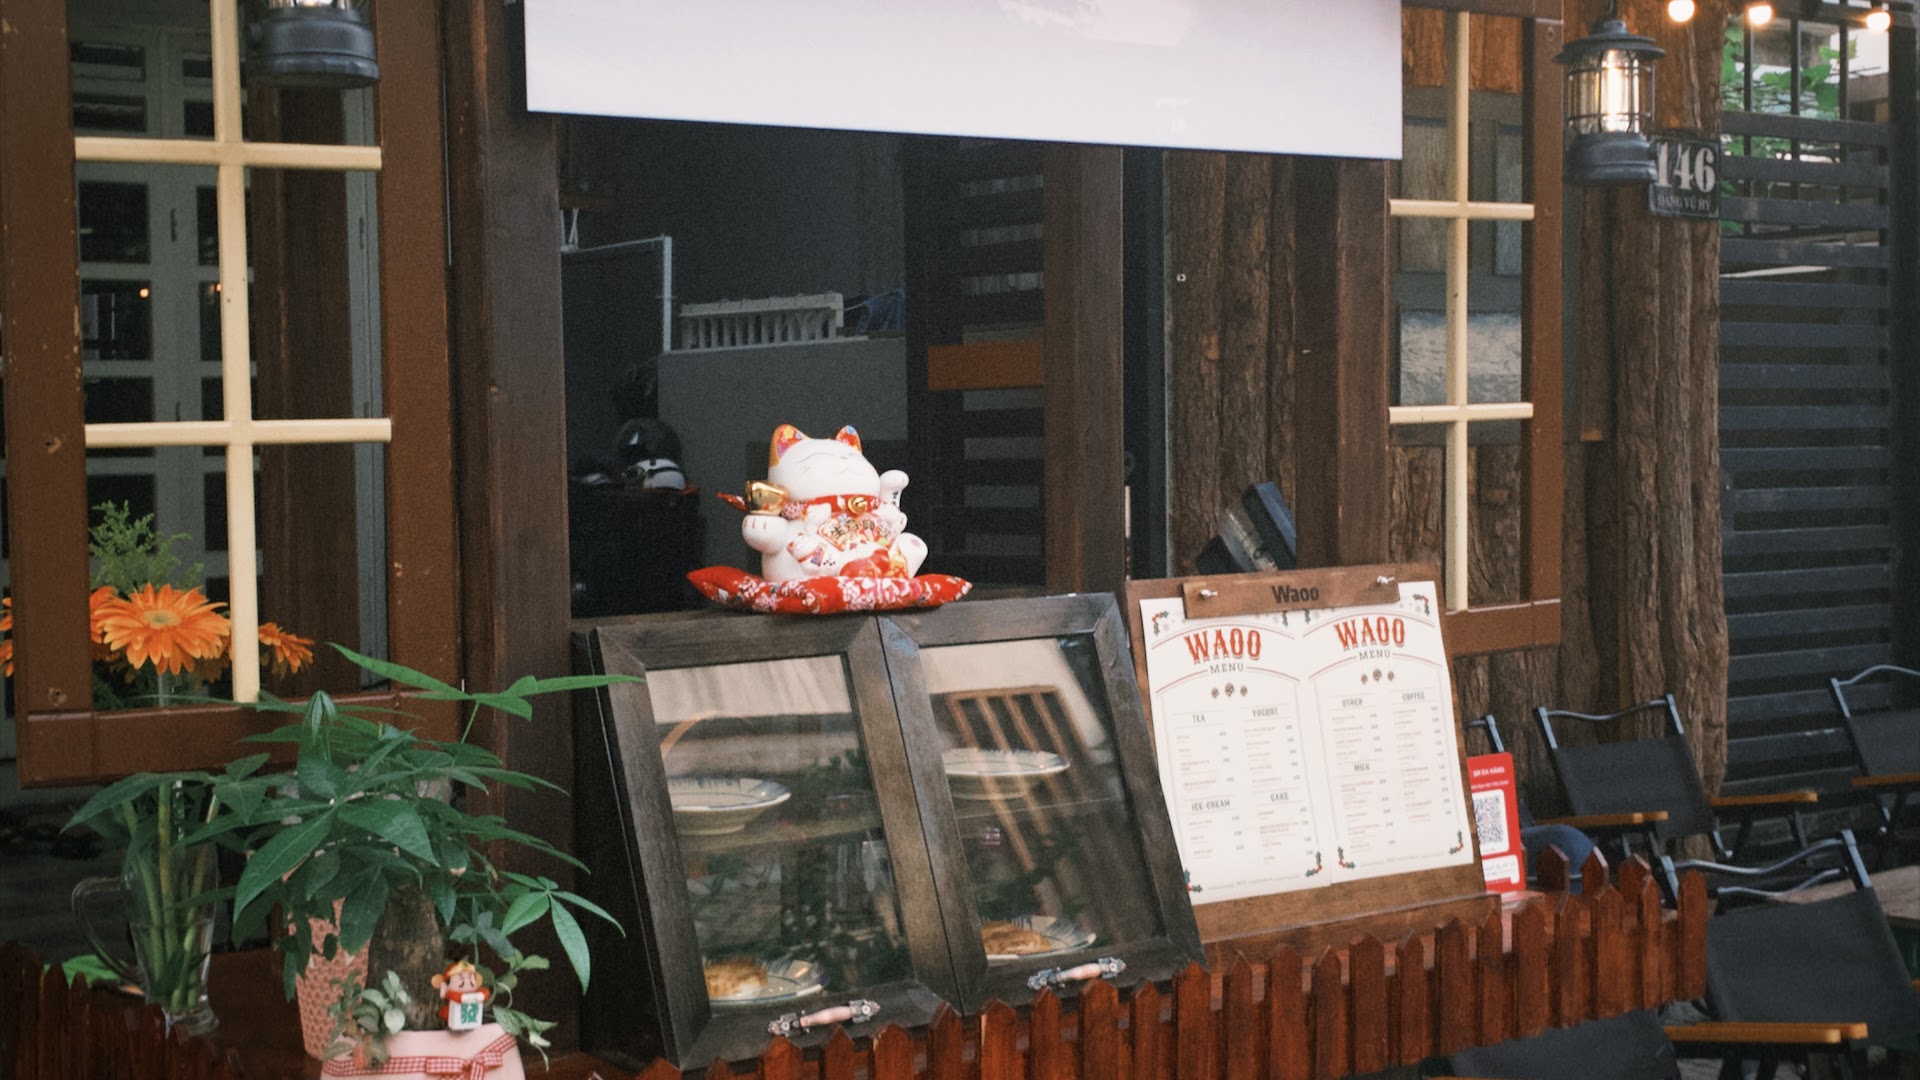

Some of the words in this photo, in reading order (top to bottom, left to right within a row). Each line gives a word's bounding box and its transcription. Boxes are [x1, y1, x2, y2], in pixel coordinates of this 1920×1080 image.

[1655, 142, 1716, 193] 146
[1271, 585, 1320, 604] Waoo
[1333, 616, 1406, 651] WAOO
[1184, 627, 1262, 665] WAOO
[1359, 650, 1391, 661] MENU
[1209, 663, 1245, 674] MENU
[1402, 691, 1425, 702] COFFEE
[1341, 698, 1363, 708] OTHER
[1192, 714, 1206, 723] TEA
[1353, 763, 1370, 773] MILK
[1270, 792, 1289, 802] CAKE
